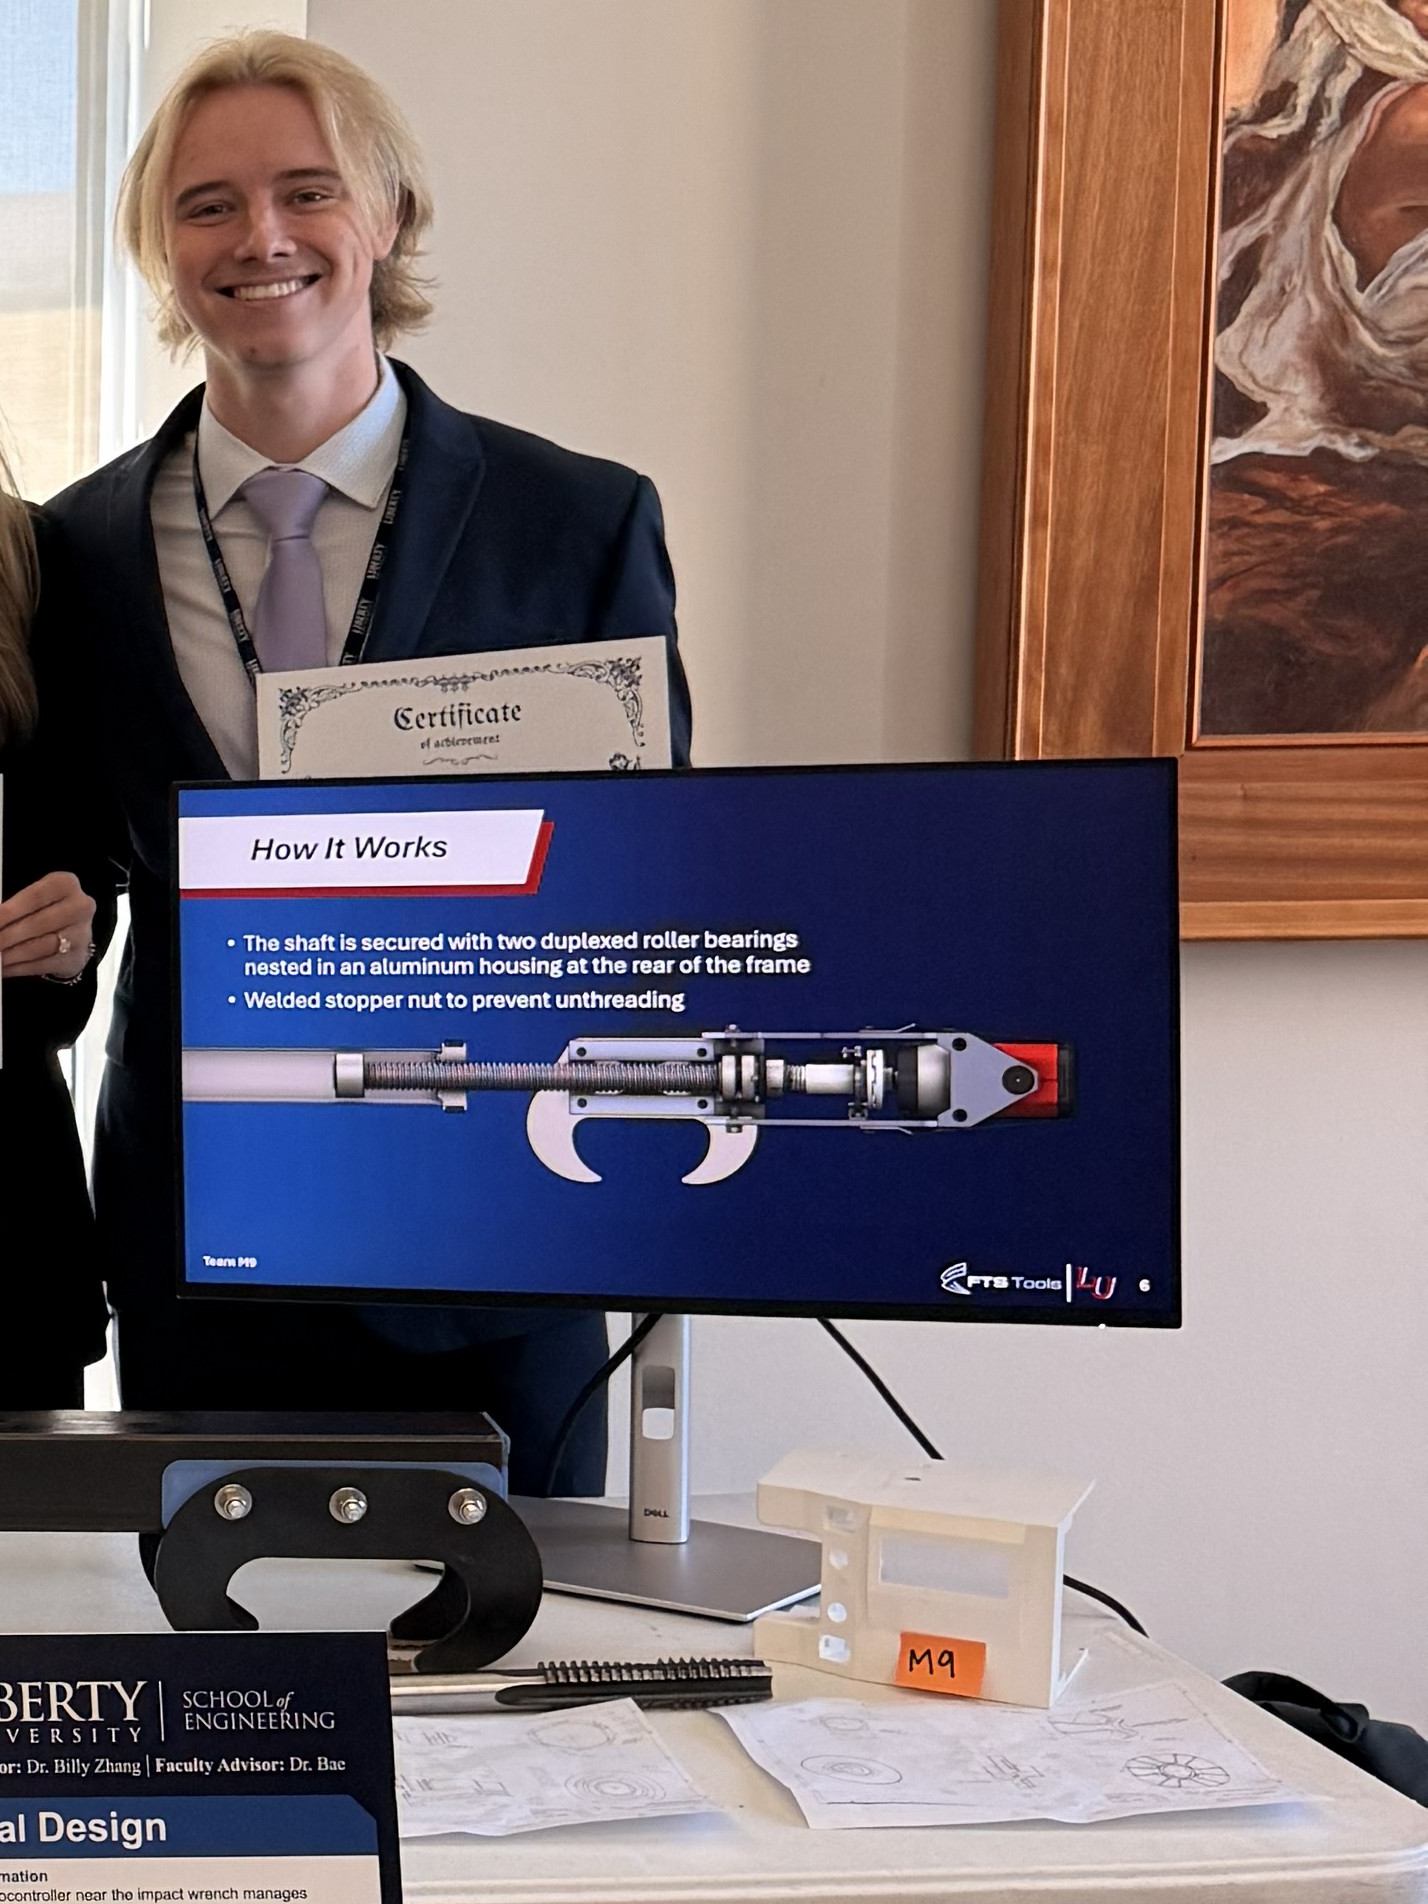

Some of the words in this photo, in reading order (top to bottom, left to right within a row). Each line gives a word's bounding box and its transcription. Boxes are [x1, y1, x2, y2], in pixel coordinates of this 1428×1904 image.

[393, 702, 521, 731] Certificate
[251, 838, 318, 861] How
[324, 837, 345, 859] It
[355, 835, 447, 859] Works
[242, 934, 280, 952] The
[284, 933, 336, 952] shaft
[339, 933, 357, 951] is
[361, 932, 444, 951] secured
[447, 932, 493, 950] with
[496, 933, 537, 950] two
[540, 931, 638, 953] duplexed
[643, 930, 700, 949] roller
[704, 929, 798, 952] bearings
[244, 957, 312, 976] nested
[316, 957, 335, 975] in
[339, 961, 365, 975] an
[369, 956, 474, 975] aluminum
[479, 956, 563, 978] housing
[566, 957, 588, 974] at
[591, 956, 627, 974] the
[632, 959, 675, 974] rear
[679, 955, 702, 974] of
[705, 955, 741, 973] the
[745, 955, 810, 973] frame
[243, 991, 320, 1009] Welded
[324, 992, 404, 1012] stopper
[407, 991, 442, 1008] nut
[445, 992, 468, 1008] to
[472, 991, 552, 1012] prevent
[555, 990, 685, 1012] unthreading
[202, 1255, 236, 1267] Team
[237, 1256, 257, 1268] M9
[968, 1276, 1008, 1288] FTS
[1012, 1277, 1062, 1290] Tools
[1139, 1280, 1150, 1291] 6
[644, 1508, 669, 1518] DELL
[909, 1649, 955, 1678] M9
[182, 1690, 273, 1708] SCHOOL
[276, 1691, 294, 1713] of
[184, 1708, 334, 1730] ENGINEERING
[26, 1759, 49, 1774] Dr.
[54, 1758, 90, 1777] Billy
[94, 1758, 141, 1776] Zhang
[155, 1757, 214, 1775] Faculty
[216, 1757, 284, 1772] Advisor:
[290, 1756, 312, 1771] Dr.
[38, 1810, 166, 1849] Design
